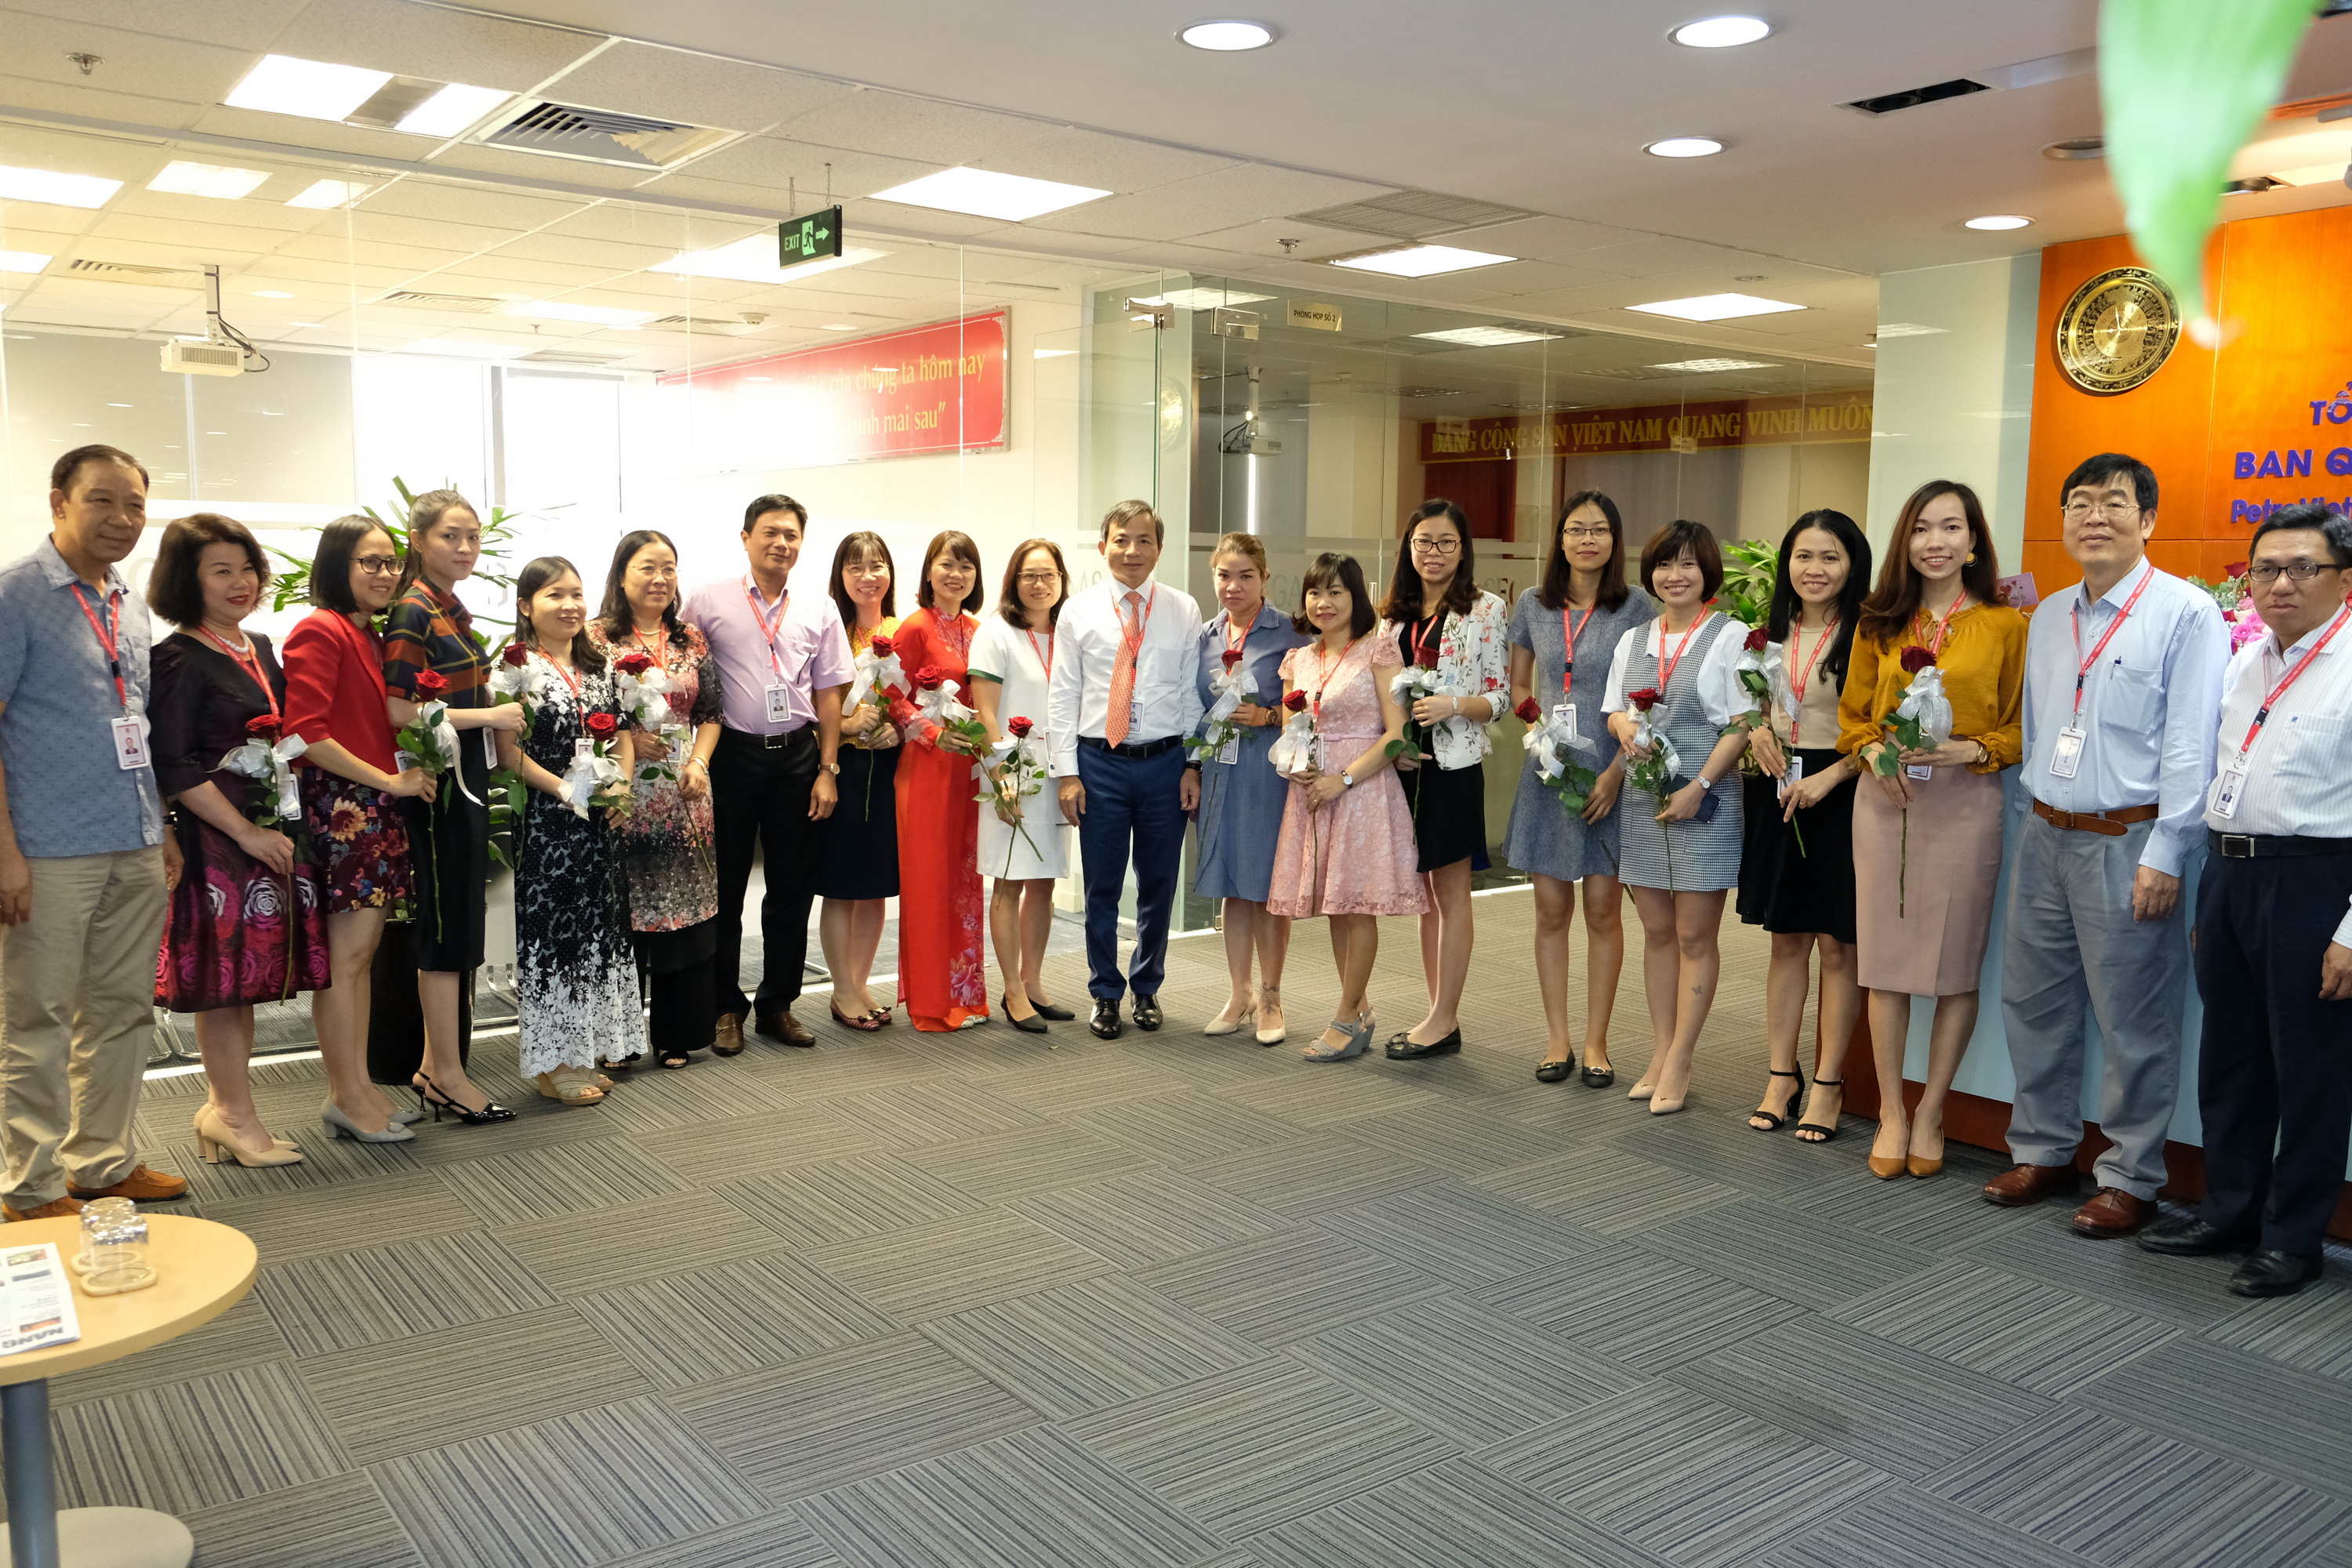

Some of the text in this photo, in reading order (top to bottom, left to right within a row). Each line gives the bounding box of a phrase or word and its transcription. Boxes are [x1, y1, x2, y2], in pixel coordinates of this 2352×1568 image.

[784, 234, 800, 251] EXIT
[1294, 308, 1312, 319] PHÒNG
[1312, 312, 1323, 321] HỌP
[1323, 311, 1331, 321] SỐ
[829, 368, 851, 395] của
[902, 361, 914, 384] ta
[920, 354, 952, 382] hôm
[958, 354, 985, 382] nay
[848, 408, 880, 437] trình
[884, 404, 909, 433] mai
[1480, 421, 1530, 456] CỘNG
[1572, 414, 1615, 451] VIỆT
[1619, 419, 1662, 442] NAM
[1668, 412, 1742, 439] QUANG
[1746, 408, 1802, 436] VINH
[2234, 448, 2313, 480] BAN
[2125, 596, 2135, 607] GAS
[2271, 687, 2282, 699] GAS
[2320, 635, 2328, 644] PV
[2325, 626, 2336, 637] GAS
